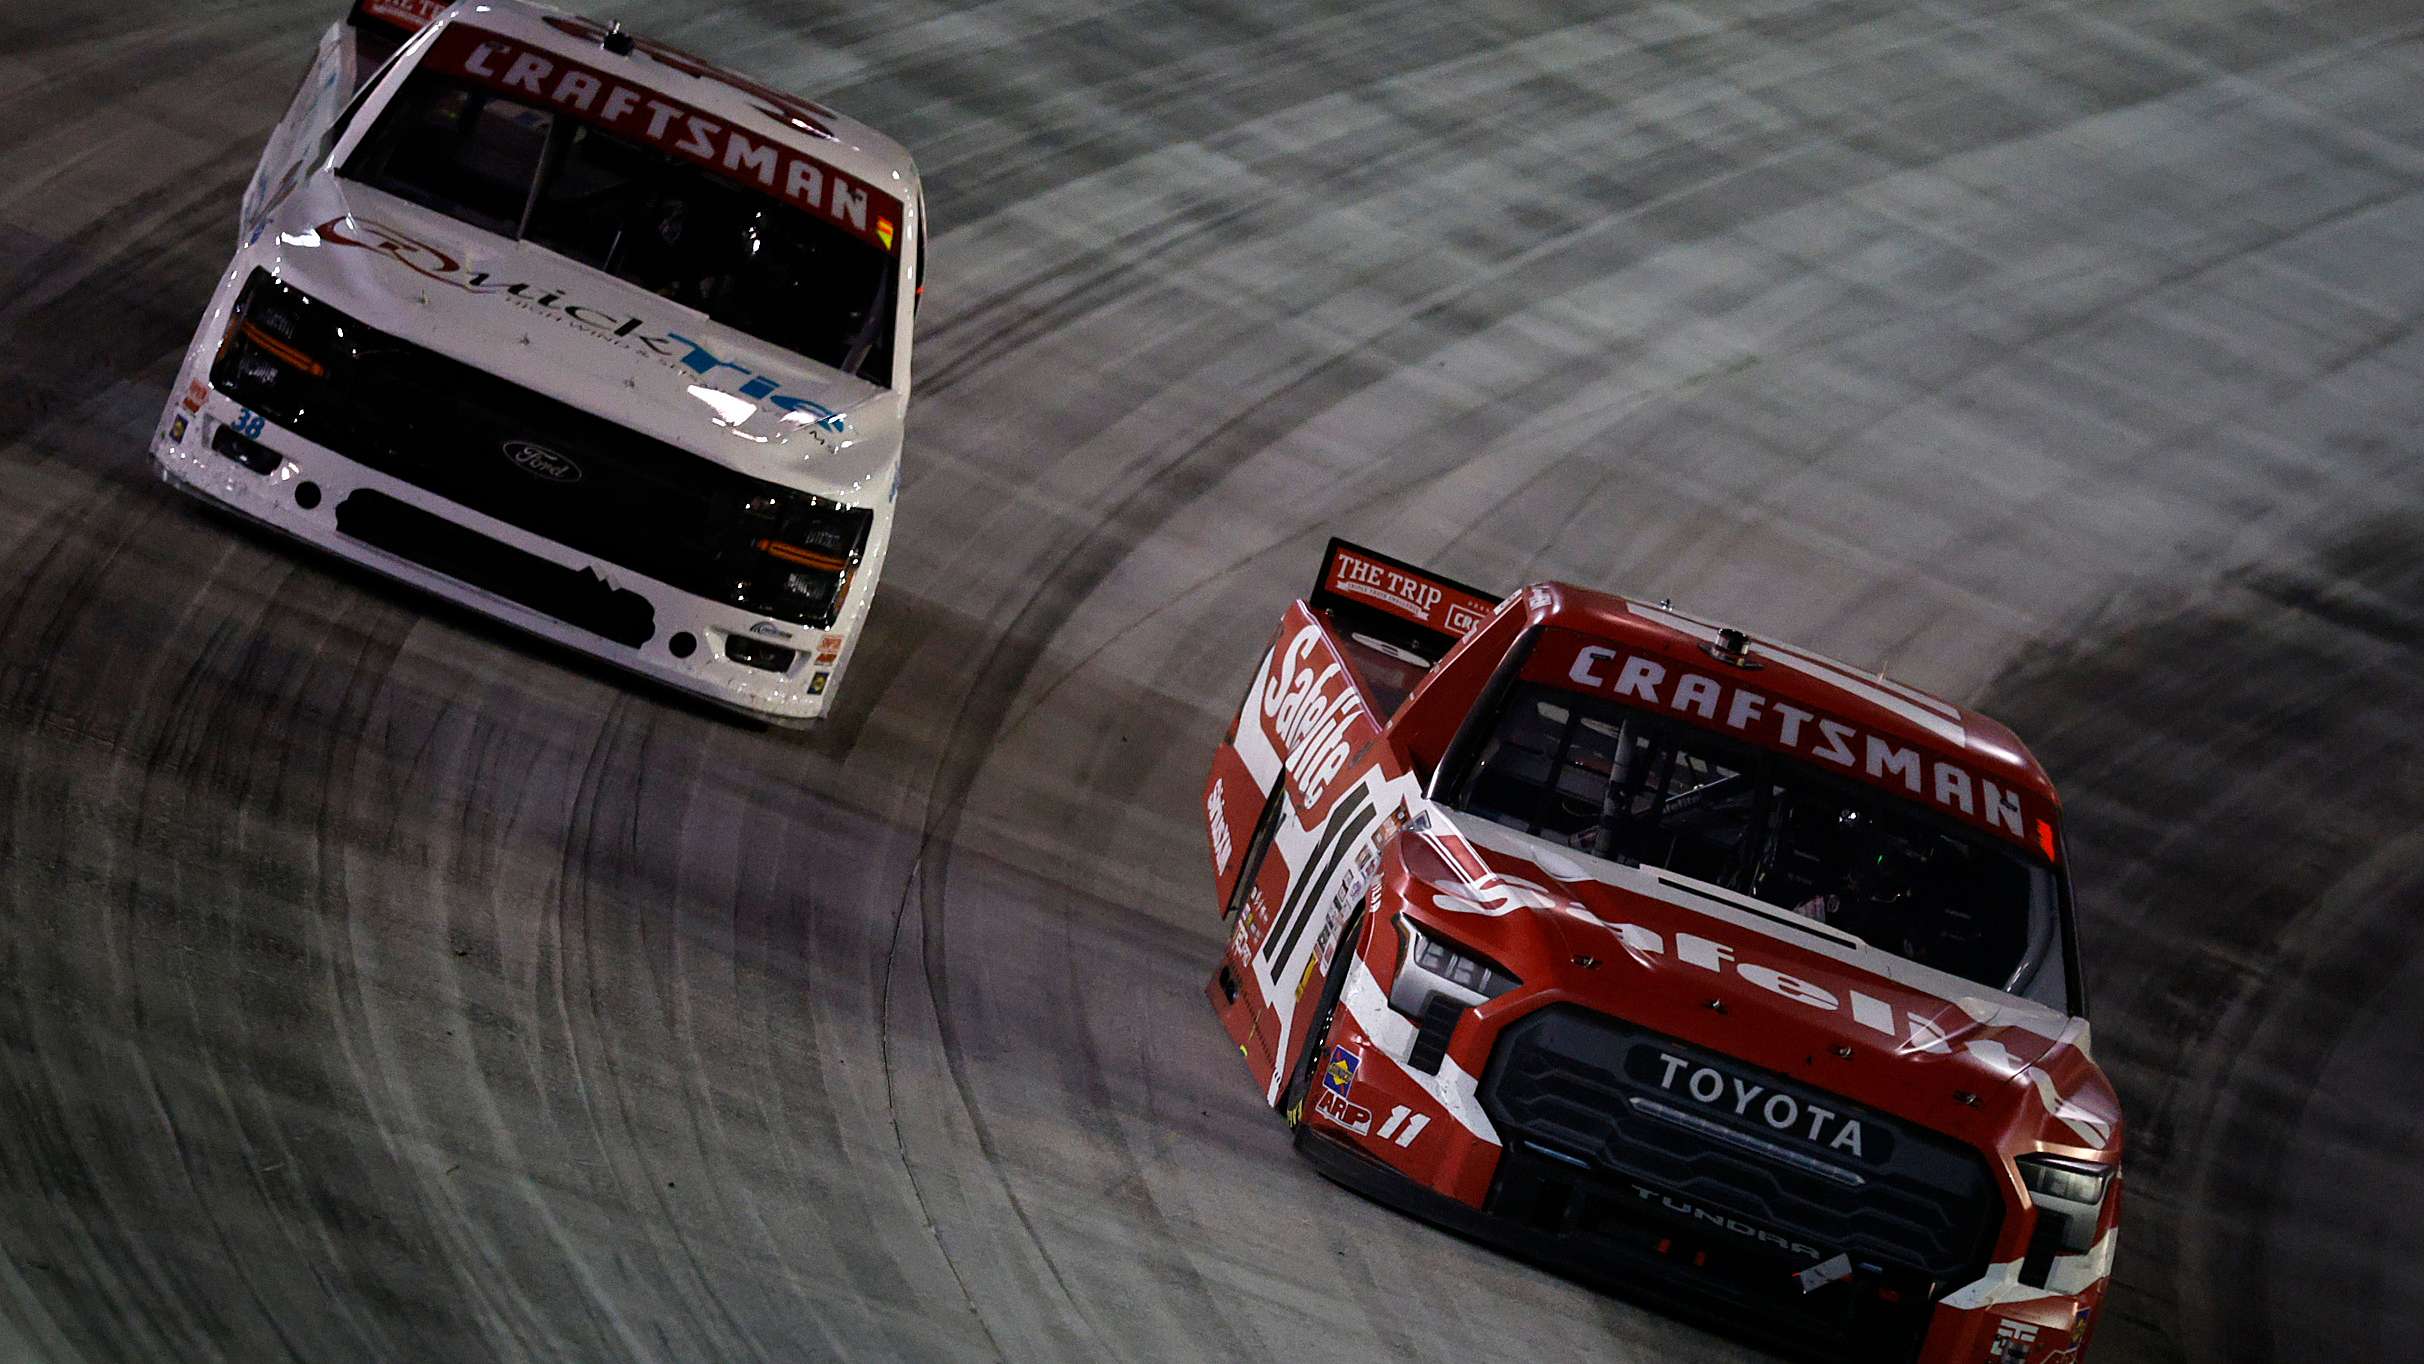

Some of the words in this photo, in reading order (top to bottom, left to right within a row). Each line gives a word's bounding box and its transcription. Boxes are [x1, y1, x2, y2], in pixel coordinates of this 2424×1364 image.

[465, 40, 870, 231] CRAFTSMAN
[231, 407, 266, 440] 38
[516, 442, 569, 478] Ford
[1338, 554, 1384, 586] THE
[1388, 572, 1442, 611] TRIP
[1264, 624, 1364, 810] Safelite
[1567, 644, 2024, 838] CRAFTSMAN
[1317, 1091, 1372, 1128] ARP
[1376, 1104, 1432, 1149] 11
[1658, 1053, 1863, 1157] TOYOTA
[1631, 1183, 1821, 1260] TUNDRA
